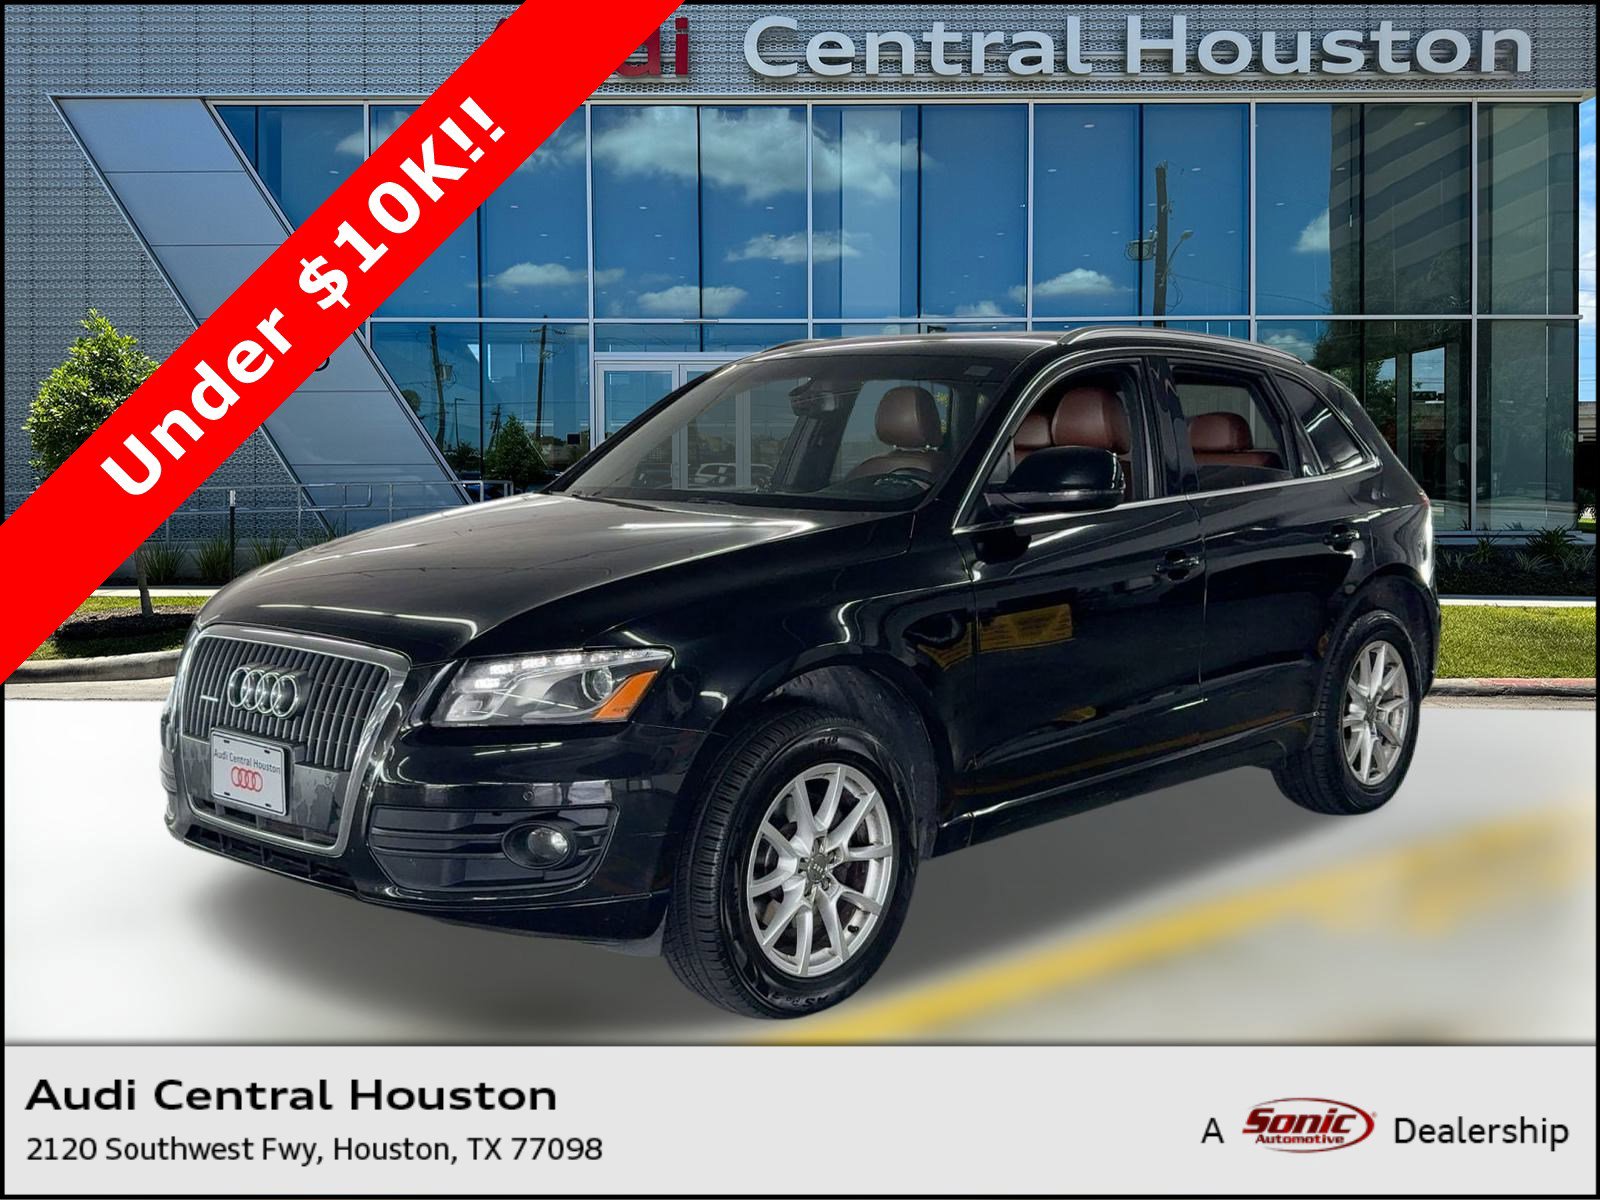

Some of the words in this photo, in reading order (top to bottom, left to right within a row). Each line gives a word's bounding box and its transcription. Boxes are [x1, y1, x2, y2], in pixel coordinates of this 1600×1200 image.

[743, 15, 1092, 77] Central
[1126, 15, 1533, 76] Houston
[214, 748, 228, 761] Audi
[229, 752, 252, 768] Central
[253, 758, 281, 775] Houston
